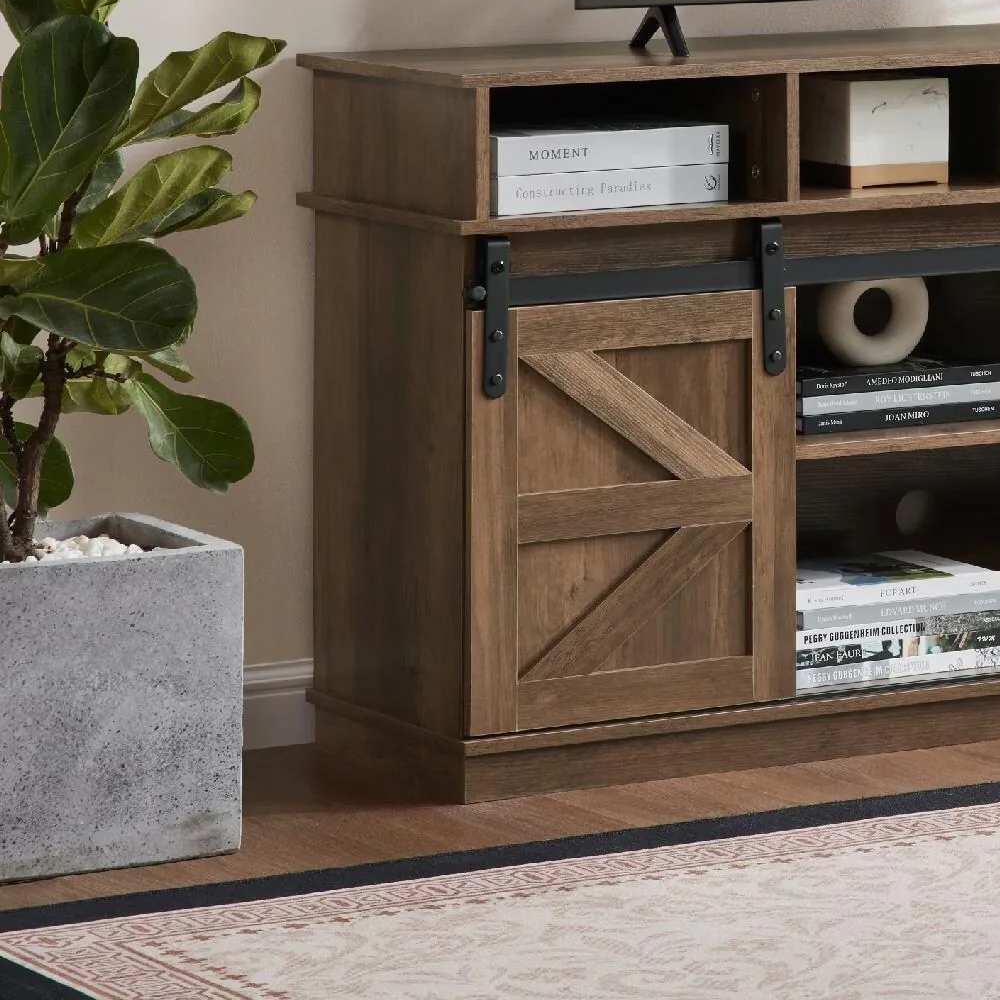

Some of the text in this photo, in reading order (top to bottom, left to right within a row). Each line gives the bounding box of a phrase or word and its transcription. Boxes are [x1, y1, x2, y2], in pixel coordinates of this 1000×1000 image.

[528, 147, 589, 161] MOMENT
[898, 373, 943, 384] MODIGLIANI
[885, 412, 907, 422] JOAN
[899, 586, 917, 596] ART
[804, 622, 926, 645] PEGGY GUGGENHEIM COLLECTION
